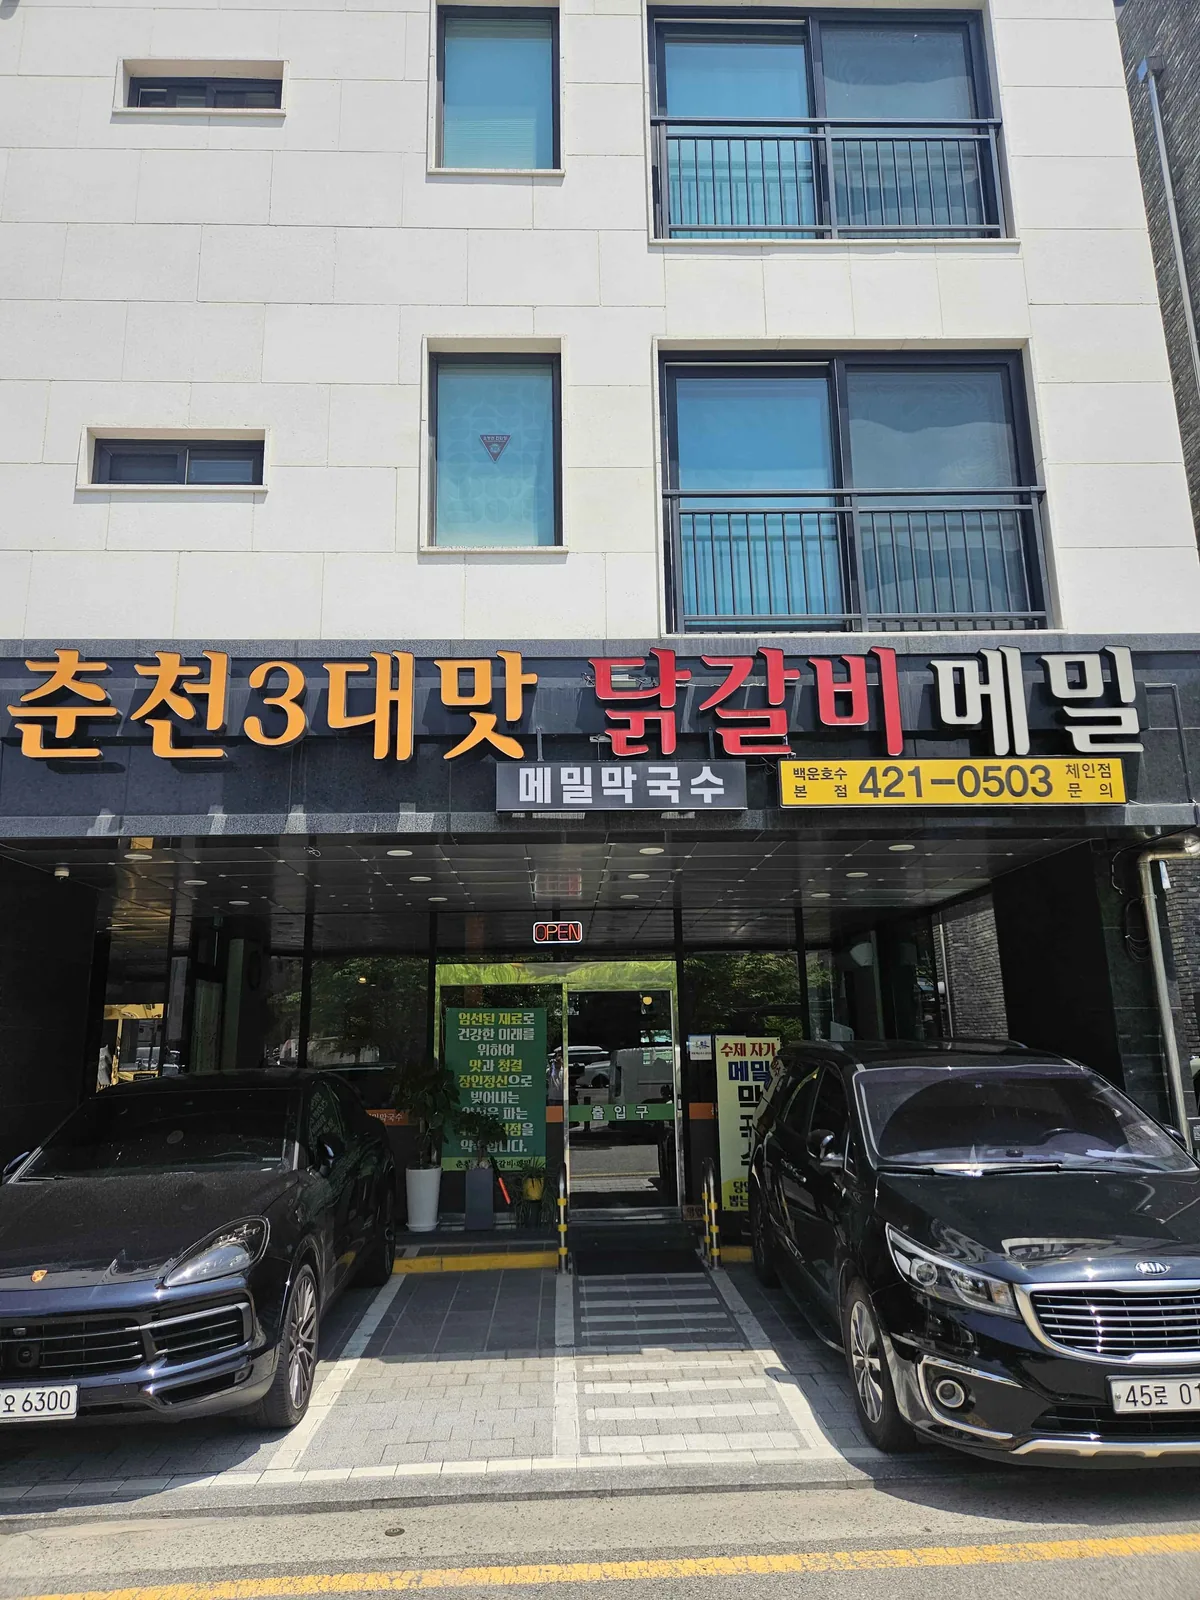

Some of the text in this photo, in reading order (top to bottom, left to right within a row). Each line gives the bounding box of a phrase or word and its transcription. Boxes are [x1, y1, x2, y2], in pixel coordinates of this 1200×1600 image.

[8, 646, 1145, 760] 춘천3대맛 닭갈비 메밀
[793, 767, 848, 781] 백운호수
[1065, 763, 1112, 779] 체인점
[858, 764, 1054, 798] 421-0503
[535, 923, 580, 941] OPEN
[459, 1013, 535, 1026] 엄선된 재료로
[458, 1028, 535, 1041] 건강한 미래를
[477, 1043, 515, 1057] 위하여
[720, 1043, 746, 1057] 수제
[750, 1043, 776, 1057] 자가
[469, 1059, 523, 1073] 맛과 청결
[459, 1074, 533, 1089] 장인정신으로
[470, 1090, 519, 1104] 빚어내는
[502, 1106, 528, 1120] 파는
[22, 1390, 71, 1412] 6300
[1126, 1385, 1168, 1407] 45로
